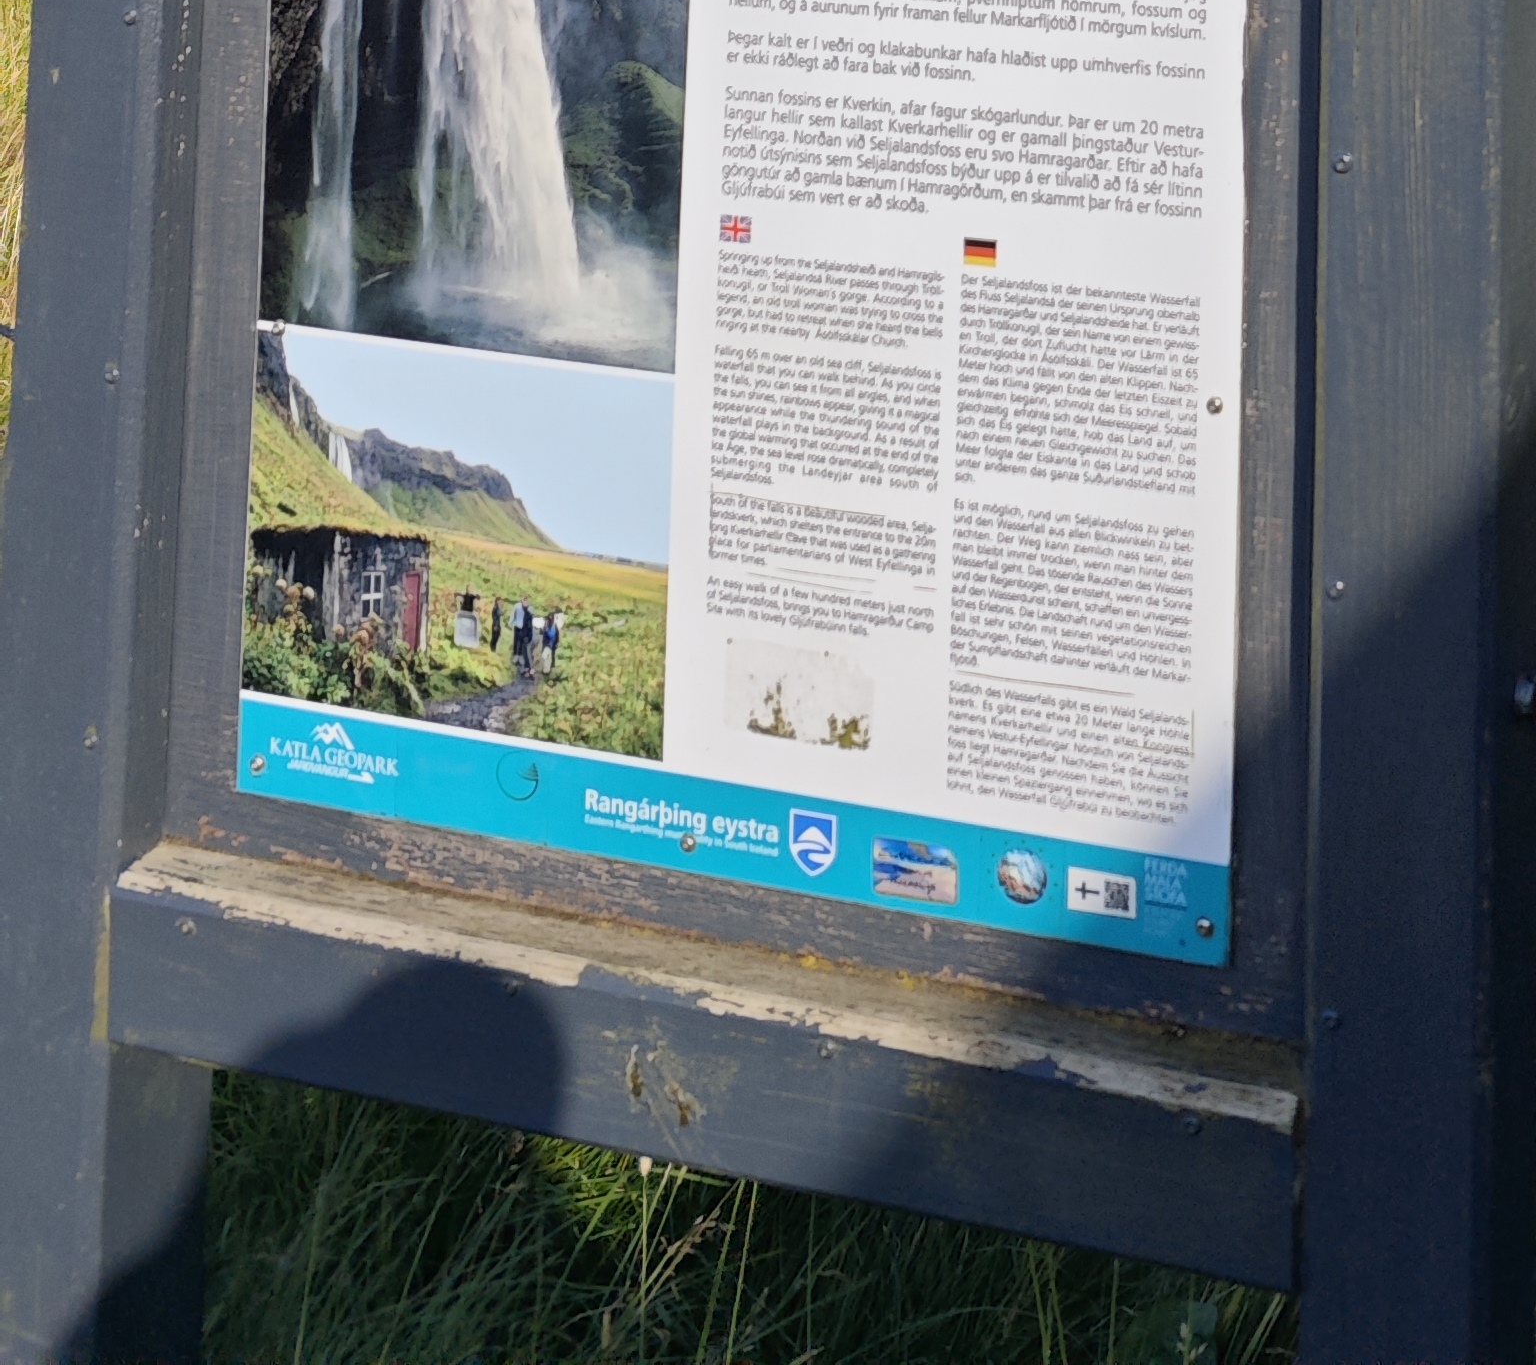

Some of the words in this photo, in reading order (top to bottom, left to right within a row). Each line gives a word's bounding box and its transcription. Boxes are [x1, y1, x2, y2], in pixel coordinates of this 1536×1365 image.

[726, 53, 740, 63] er
[742, 50, 769, 65] ekki
[772, 52, 819, 73] ráðlegt
[821, 56, 840, 71] að
[842, 57, 869, 73] fara
[872, 60, 897, 75] bak
[900, 62, 921, 77] við
[727, 29, 764, 49] Þegar
[767, 32, 792, 48] kalt
[795, 39, 810, 49] er
[813, 35, 818, 49] í
[820, 38, 854, 53] veðri
[857, 44, 875, 58] og
[965, 47, 997, 64] hafa
[1000, 50, 1047, 67] hlaðist
[1050, 59, 1078, 75] upp
[1155, 61, 1205, 80] fossinn
[269, 735, 322, 763] KATLA
[324, 747, 400, 777] GEOPARK
[584, 787, 708, 835] Rangárþing
[712, 814, 780, 843] eystra
